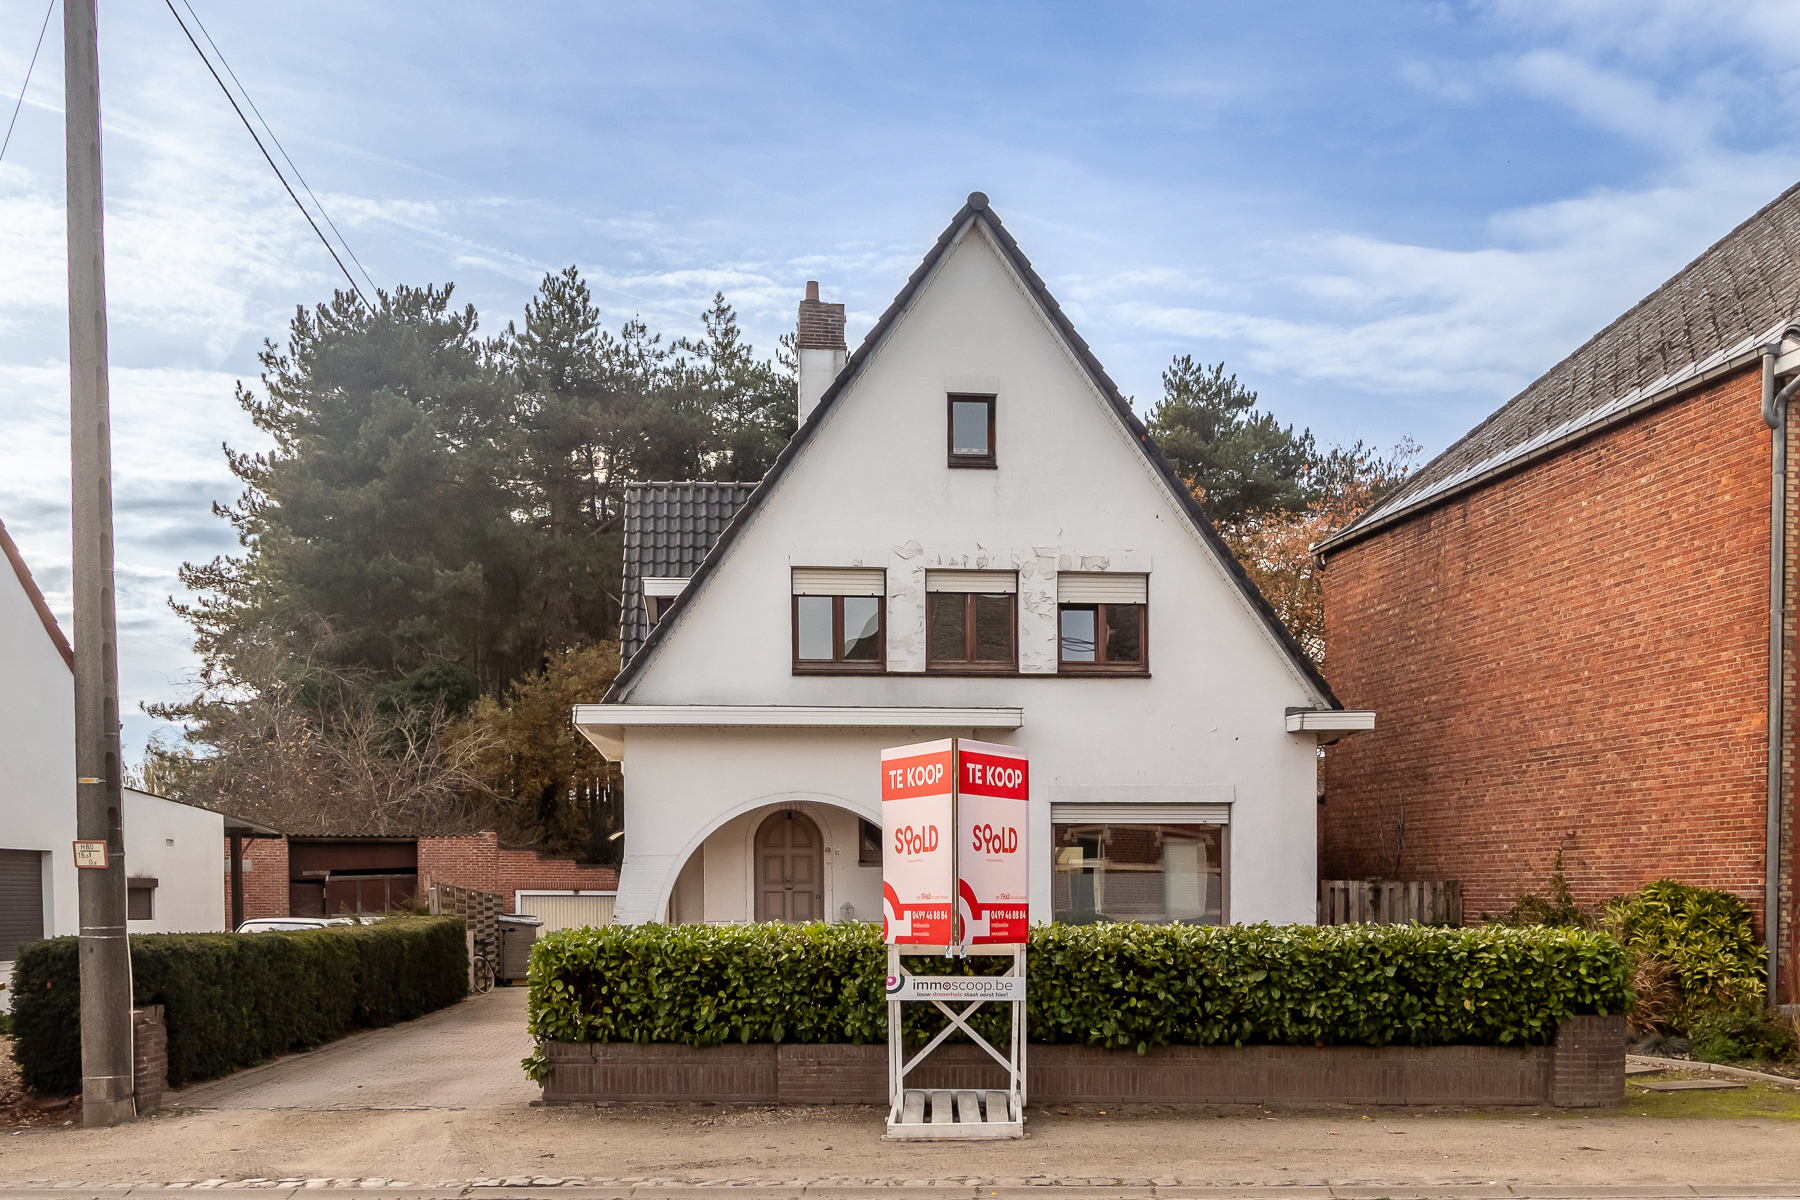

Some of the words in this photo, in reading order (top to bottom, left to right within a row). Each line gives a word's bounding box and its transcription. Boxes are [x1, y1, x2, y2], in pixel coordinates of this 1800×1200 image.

[888, 769, 904, 790] TE
[907, 763, 944, 788] KOOP
[966, 762, 983, 785] TE
[986, 765, 1023, 789] KOOP
[912, 910, 926, 920] 0499
[990, 910, 1005, 920] 0499
[912, 978, 1013, 992] immoscoop.be
